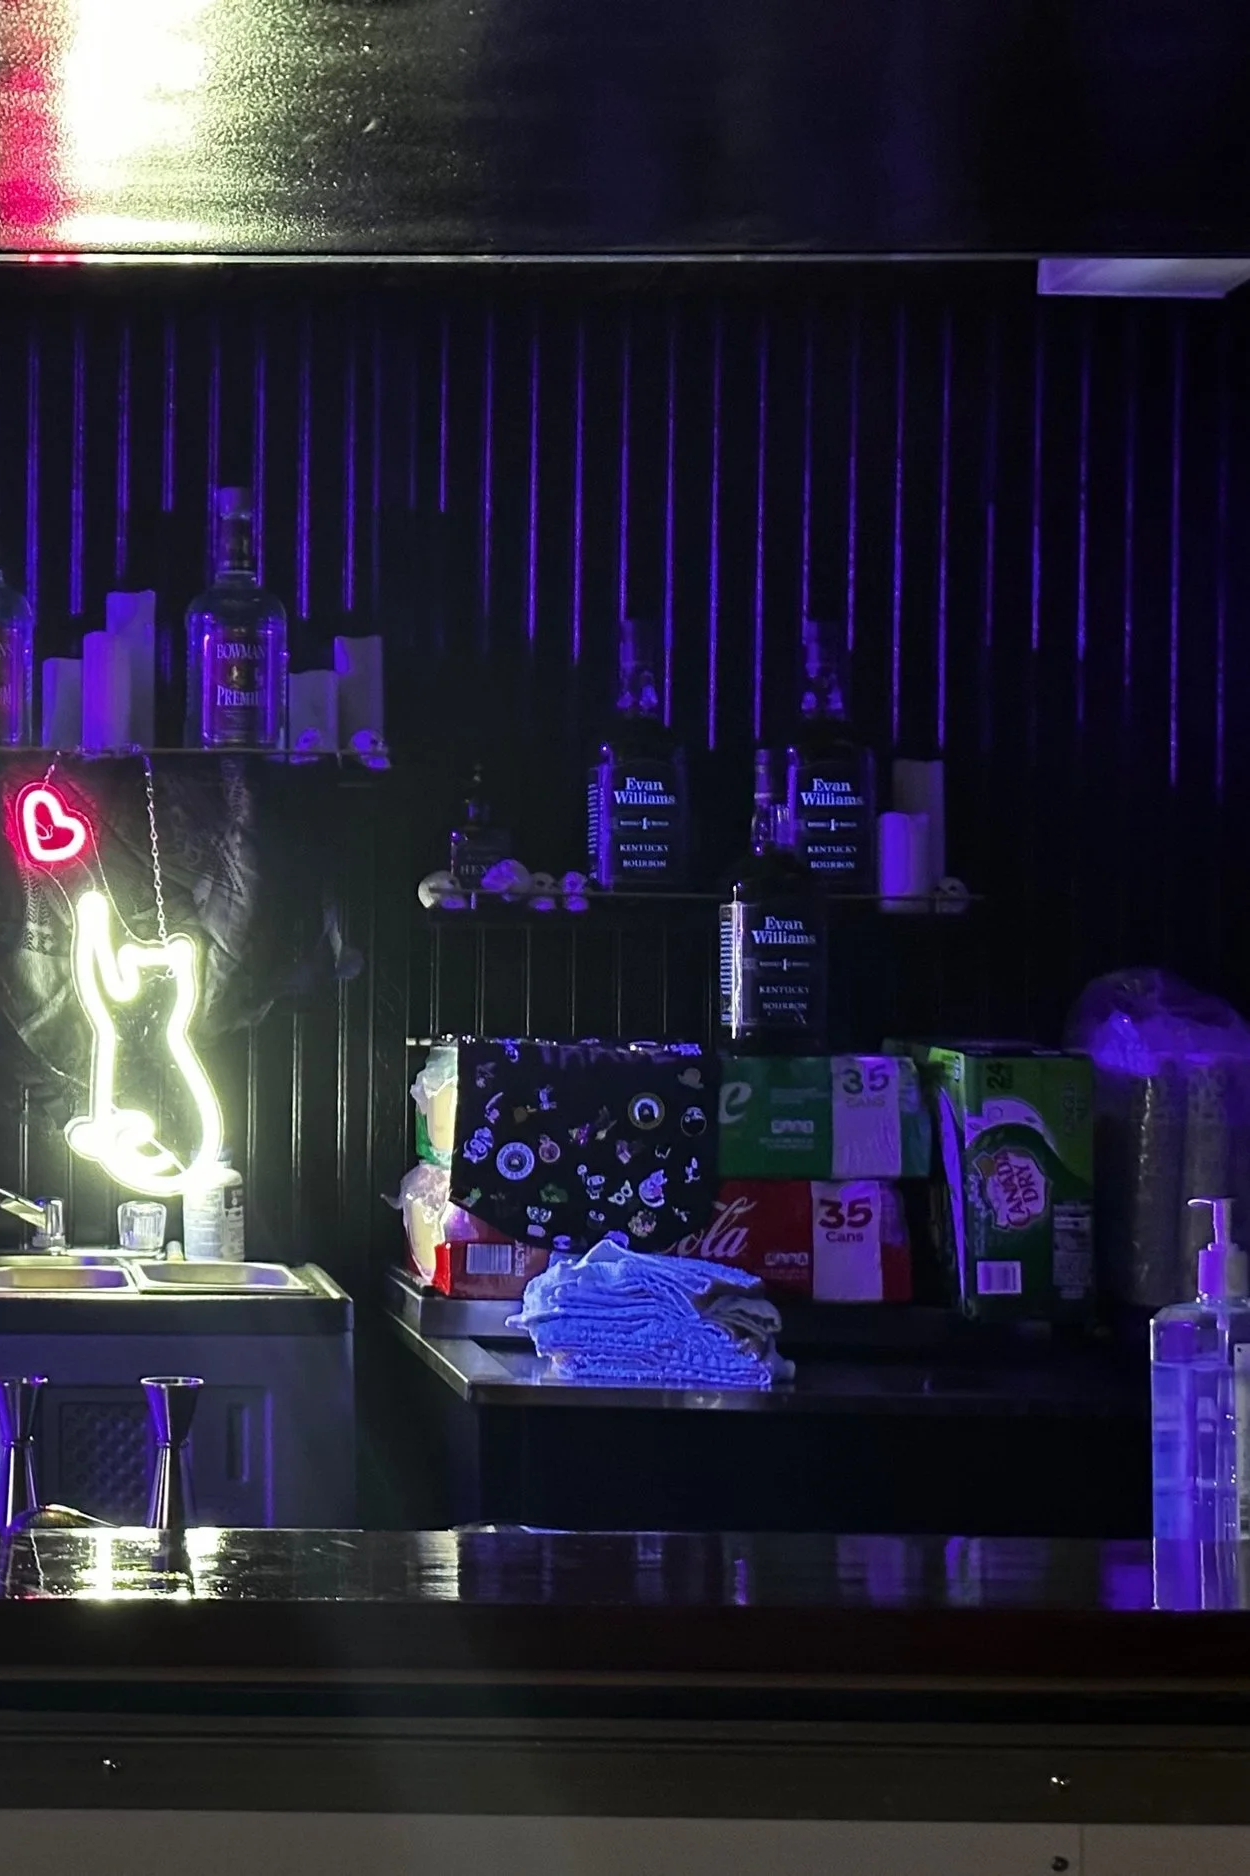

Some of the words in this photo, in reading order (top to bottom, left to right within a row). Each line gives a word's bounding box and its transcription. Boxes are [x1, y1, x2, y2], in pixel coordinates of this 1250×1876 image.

[625, 776, 664, 791] Evan
[812, 778, 852, 792] Evan
[614, 790, 677, 805] Williams
[800, 792, 865, 806] Williams
[619, 844, 669, 852] KENTUCKY
[807, 845, 857, 854] KENTUCKY
[622, 859, 667, 868] BOURBON
[810, 860, 856, 869] BOURBON
[764, 916, 804, 931] Evan
[751, 930, 817, 945] Williams
[759, 985, 809, 995] KENTUCKY
[842, 1064, 890, 1095] 35
[986, 1061, 1004, 1090] 24
[994, 1149, 1031, 1229] CANADA
[1019, 1163, 1039, 1204] DRY
[818, 1196, 874, 1229] 35
[825, 1231, 864, 1243] Cans
